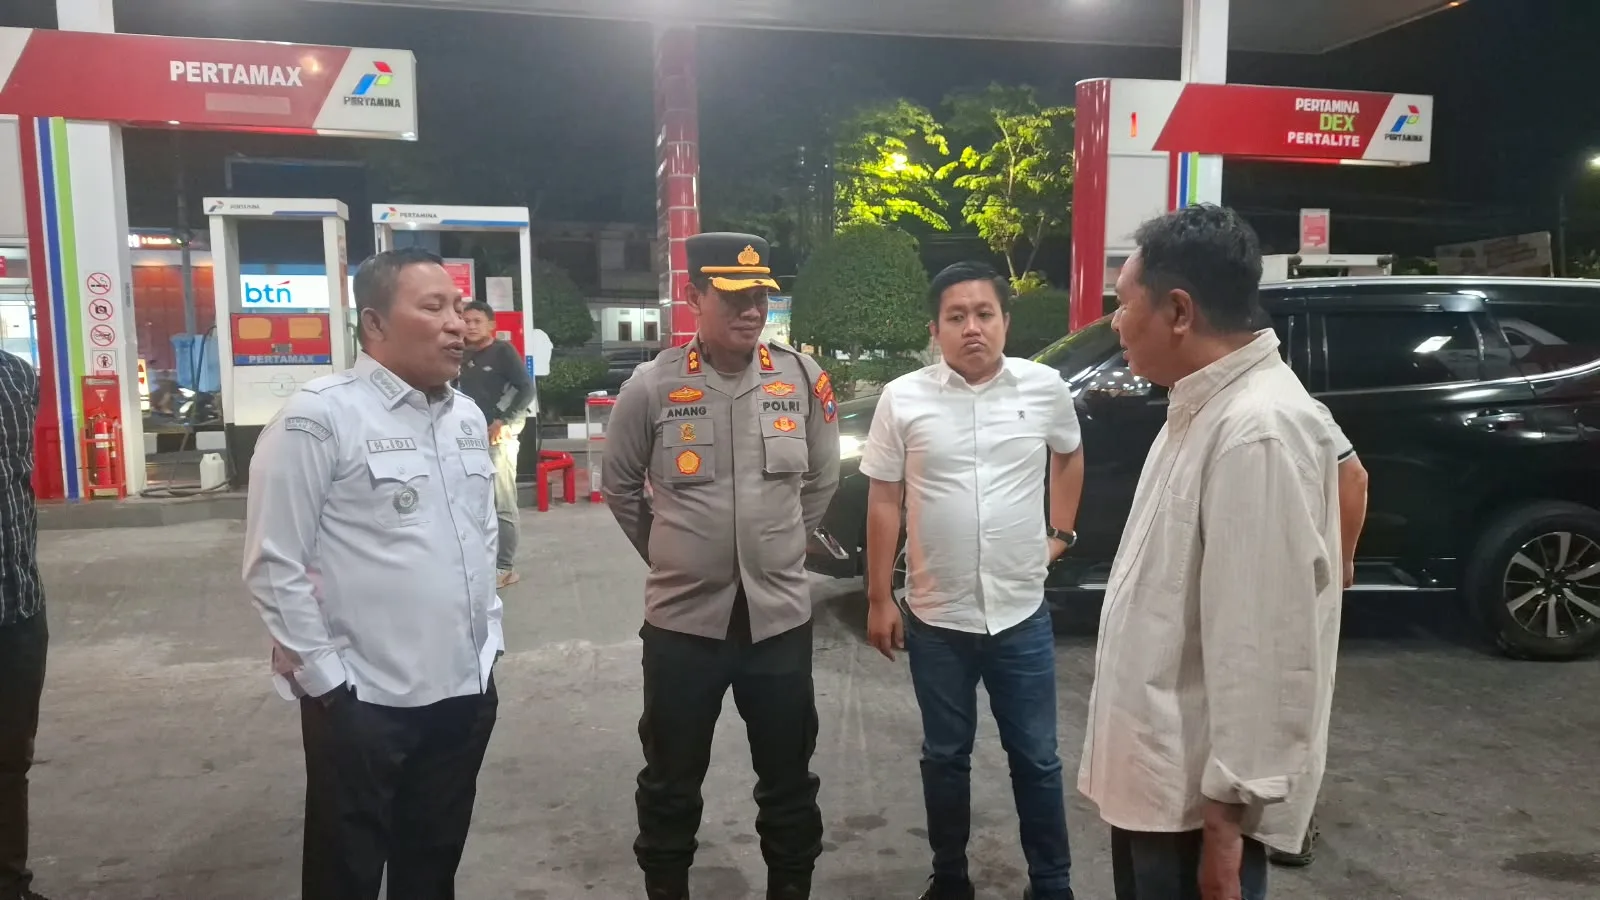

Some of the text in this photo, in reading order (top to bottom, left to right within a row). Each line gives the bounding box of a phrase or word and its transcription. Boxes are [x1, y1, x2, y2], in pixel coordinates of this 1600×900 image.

[170, 61, 302, 86] PERTAMAX
[343, 96, 401, 108] PERTAMINA
[1296, 98, 1360, 114] PERTAMINA
[1320, 113, 1355, 132] DEX
[1287, 132, 1360, 147] PERTALITE
[245, 281, 291, 303] btn
[248, 355, 313, 364] PERTAMAX
[667, 406, 707, 418] ANANG
[763, 401, 800, 412] POLRI
